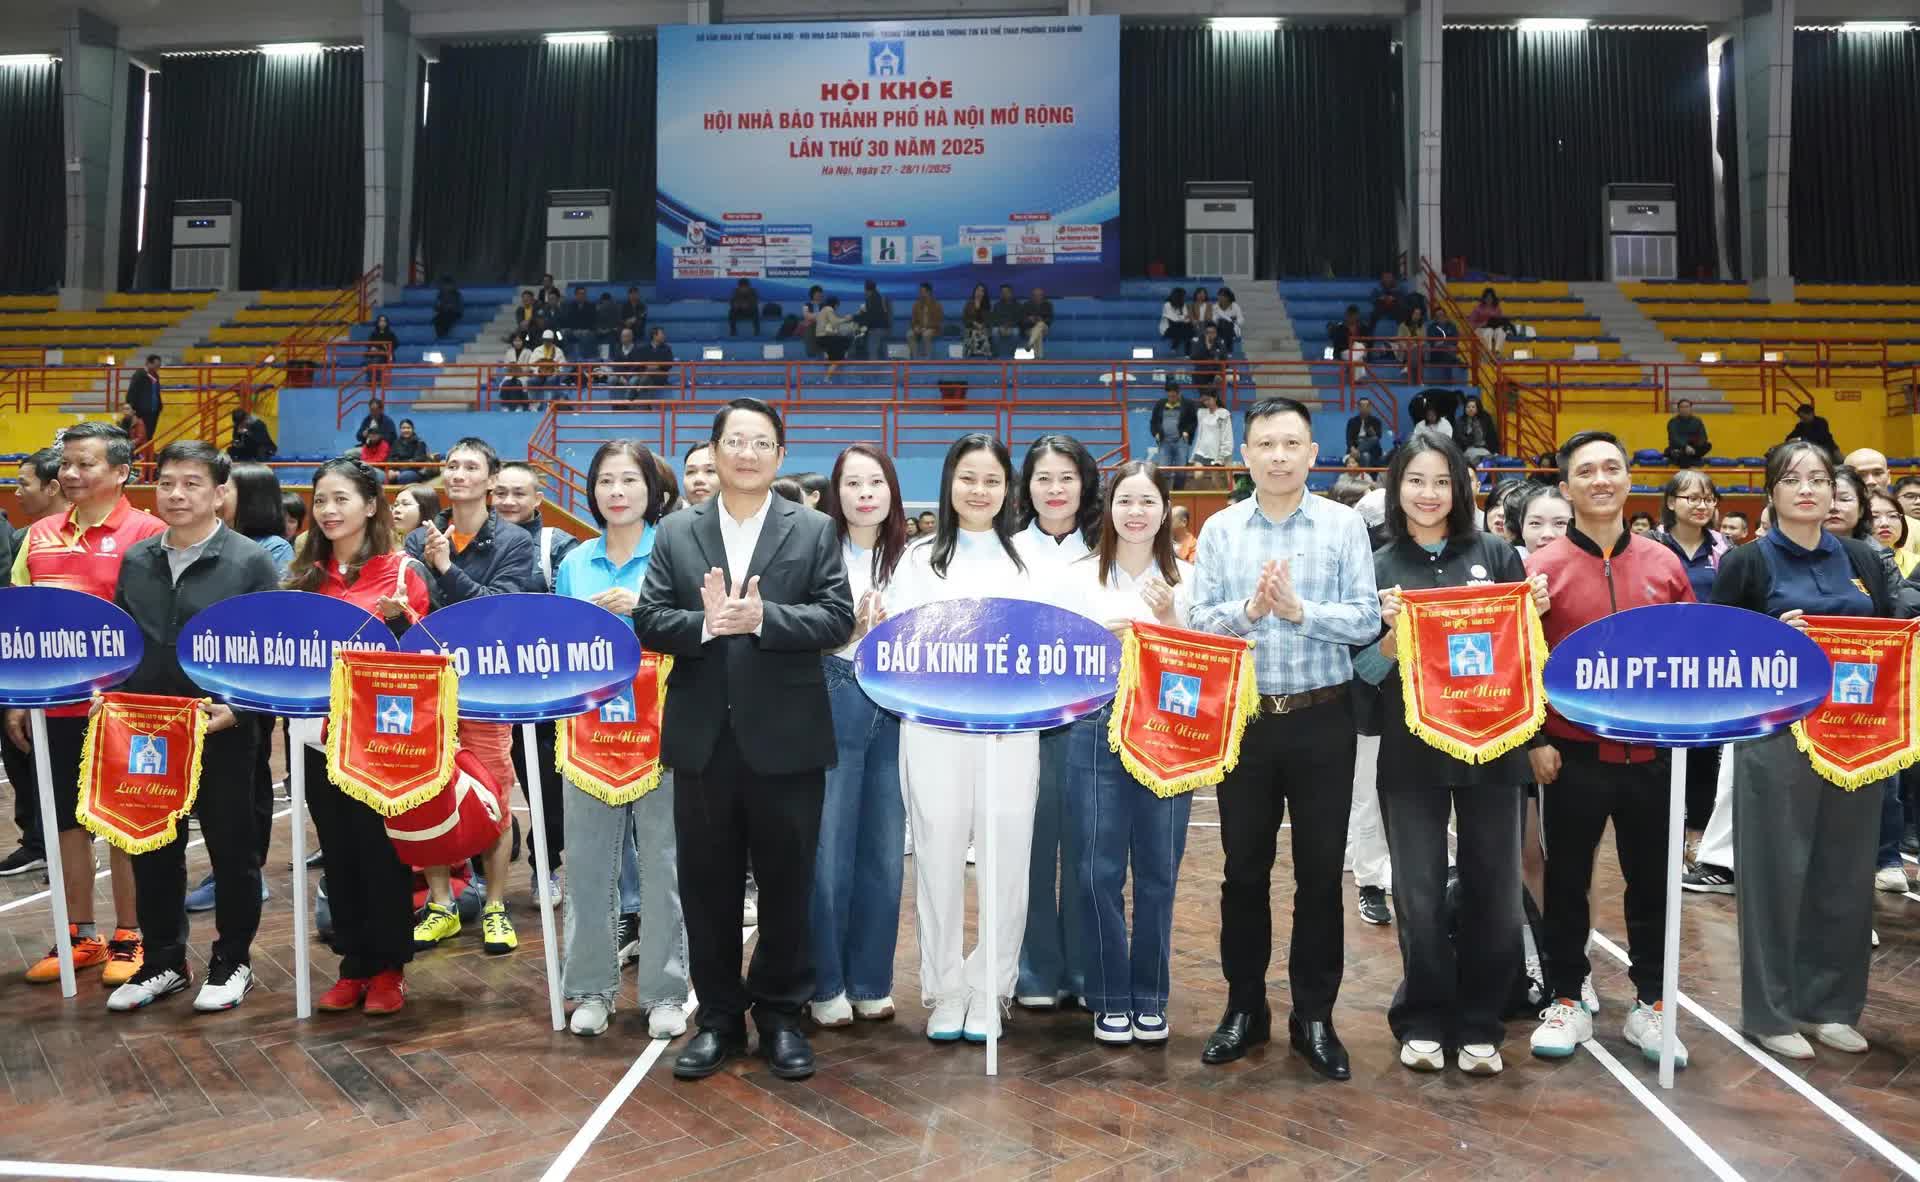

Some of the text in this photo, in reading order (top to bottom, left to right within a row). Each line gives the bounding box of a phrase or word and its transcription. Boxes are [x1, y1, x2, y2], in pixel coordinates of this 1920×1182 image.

[821, 76, 953, 105] HỘI KHỎE
[704, 102, 1073, 134] HỘI NHÀ BÁO THÀNH PHỐ HÀ NỘI MỞ RỘNG
[790, 136, 985, 158] LẦN THỨ 30 NĂM 2025
[881, 165, 892, 175] 27
[0, 624, 125, 659] BÁO HƯNG YÊN
[193, 629, 220, 669] HỘI
[225, 630, 260, 664] NHÀ
[263, 631, 295, 666] BÁO
[300, 629, 327, 668] HẢI
[477, 639, 511, 675] HÀ
[517, 637, 560, 679] NỘI
[567, 635, 614, 672] MỚI
[877, 633, 1106, 683] BÁO KINH TẾ & ĐÔ THỊ
[1576, 649, 1798, 696] ĐÀI PT-TH HÀ NỘI
